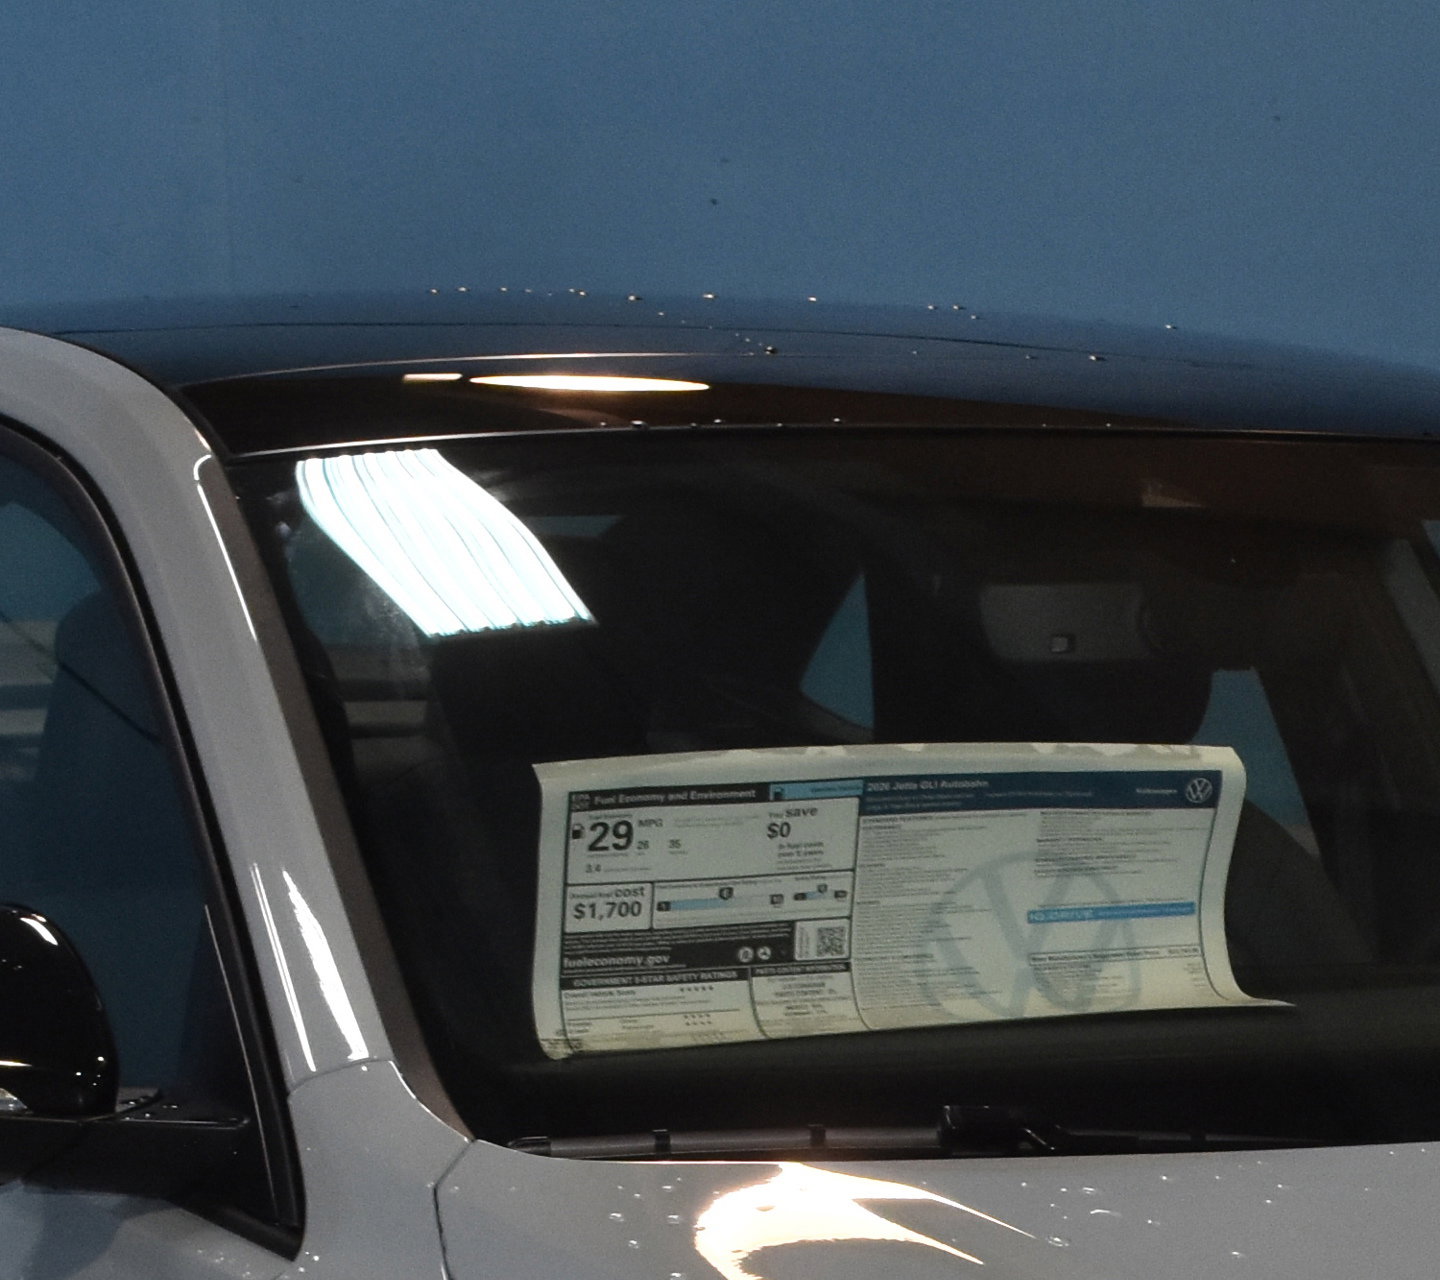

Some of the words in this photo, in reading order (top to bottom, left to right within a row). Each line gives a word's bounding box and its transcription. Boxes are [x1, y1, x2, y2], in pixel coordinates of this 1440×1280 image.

[619, 793, 665, 803] Economy
[667, 791, 687, 801] and
[689, 789, 756, 800] Environment
[785, 807, 818, 818] save
[637, 818, 664, 828] MPG
[587, 820, 634, 852] 29
[766, 821, 791, 839] $0
[614, 886, 645, 898] cost
[572, 901, 642, 921] $1,700
[563, 955, 670, 968] fueleconomy.gov
